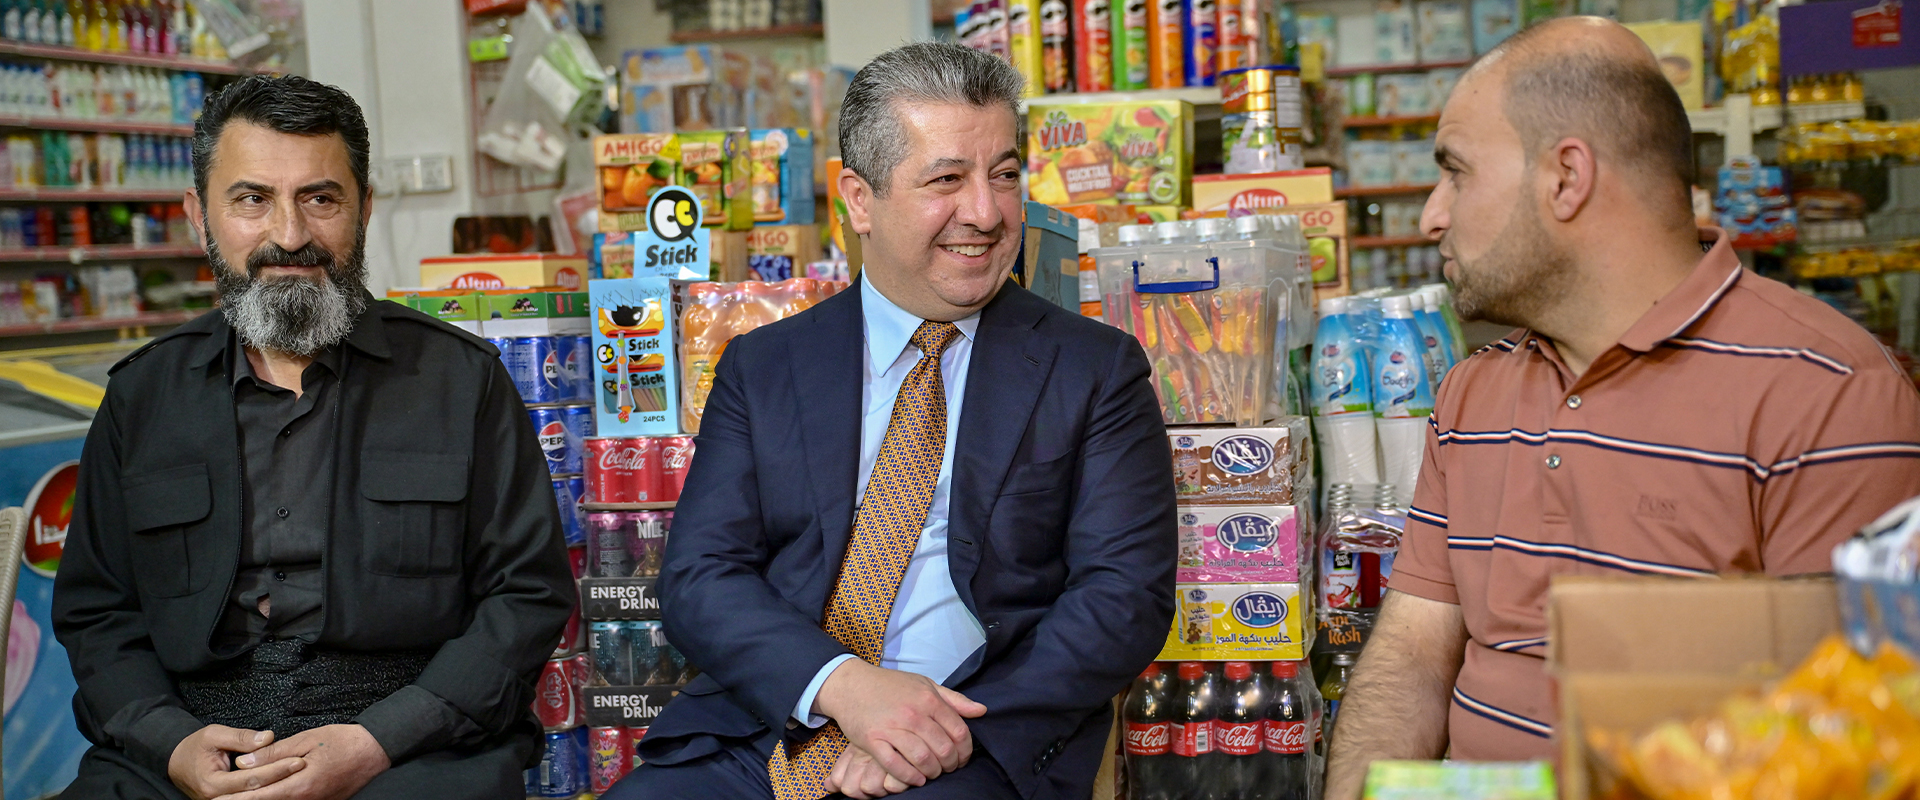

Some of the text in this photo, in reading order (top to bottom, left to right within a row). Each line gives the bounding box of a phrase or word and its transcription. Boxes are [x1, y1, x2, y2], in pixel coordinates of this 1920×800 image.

[1039, 121, 1087, 150] VIVA
[603, 140, 664, 157] AMIGO
[1120, 141, 1157, 158] VIVA
[1234, 193, 1285, 208] Altun
[748, 231, 790, 247] MIGO
[645, 245, 698, 267] Stick
[456, 276, 502, 289] Altun
[629, 338, 660, 351] Stick
[630, 373, 665, 386] Stick
[636, 521, 664, 539] NILE
[1238, 559, 1258, 568] بنكهة
[1261, 558, 1284, 568] حليب
[590, 586, 647, 600] ENERGY
[620, 599, 660, 610] DRIN
[1236, 596, 1282, 620] ريڤال
[1215, 632, 1292, 645] حليب بنكهة الموز
[1328, 626, 1361, 645] Rash
[593, 695, 649, 707] ENERGY
[623, 706, 663, 718] DRIN
